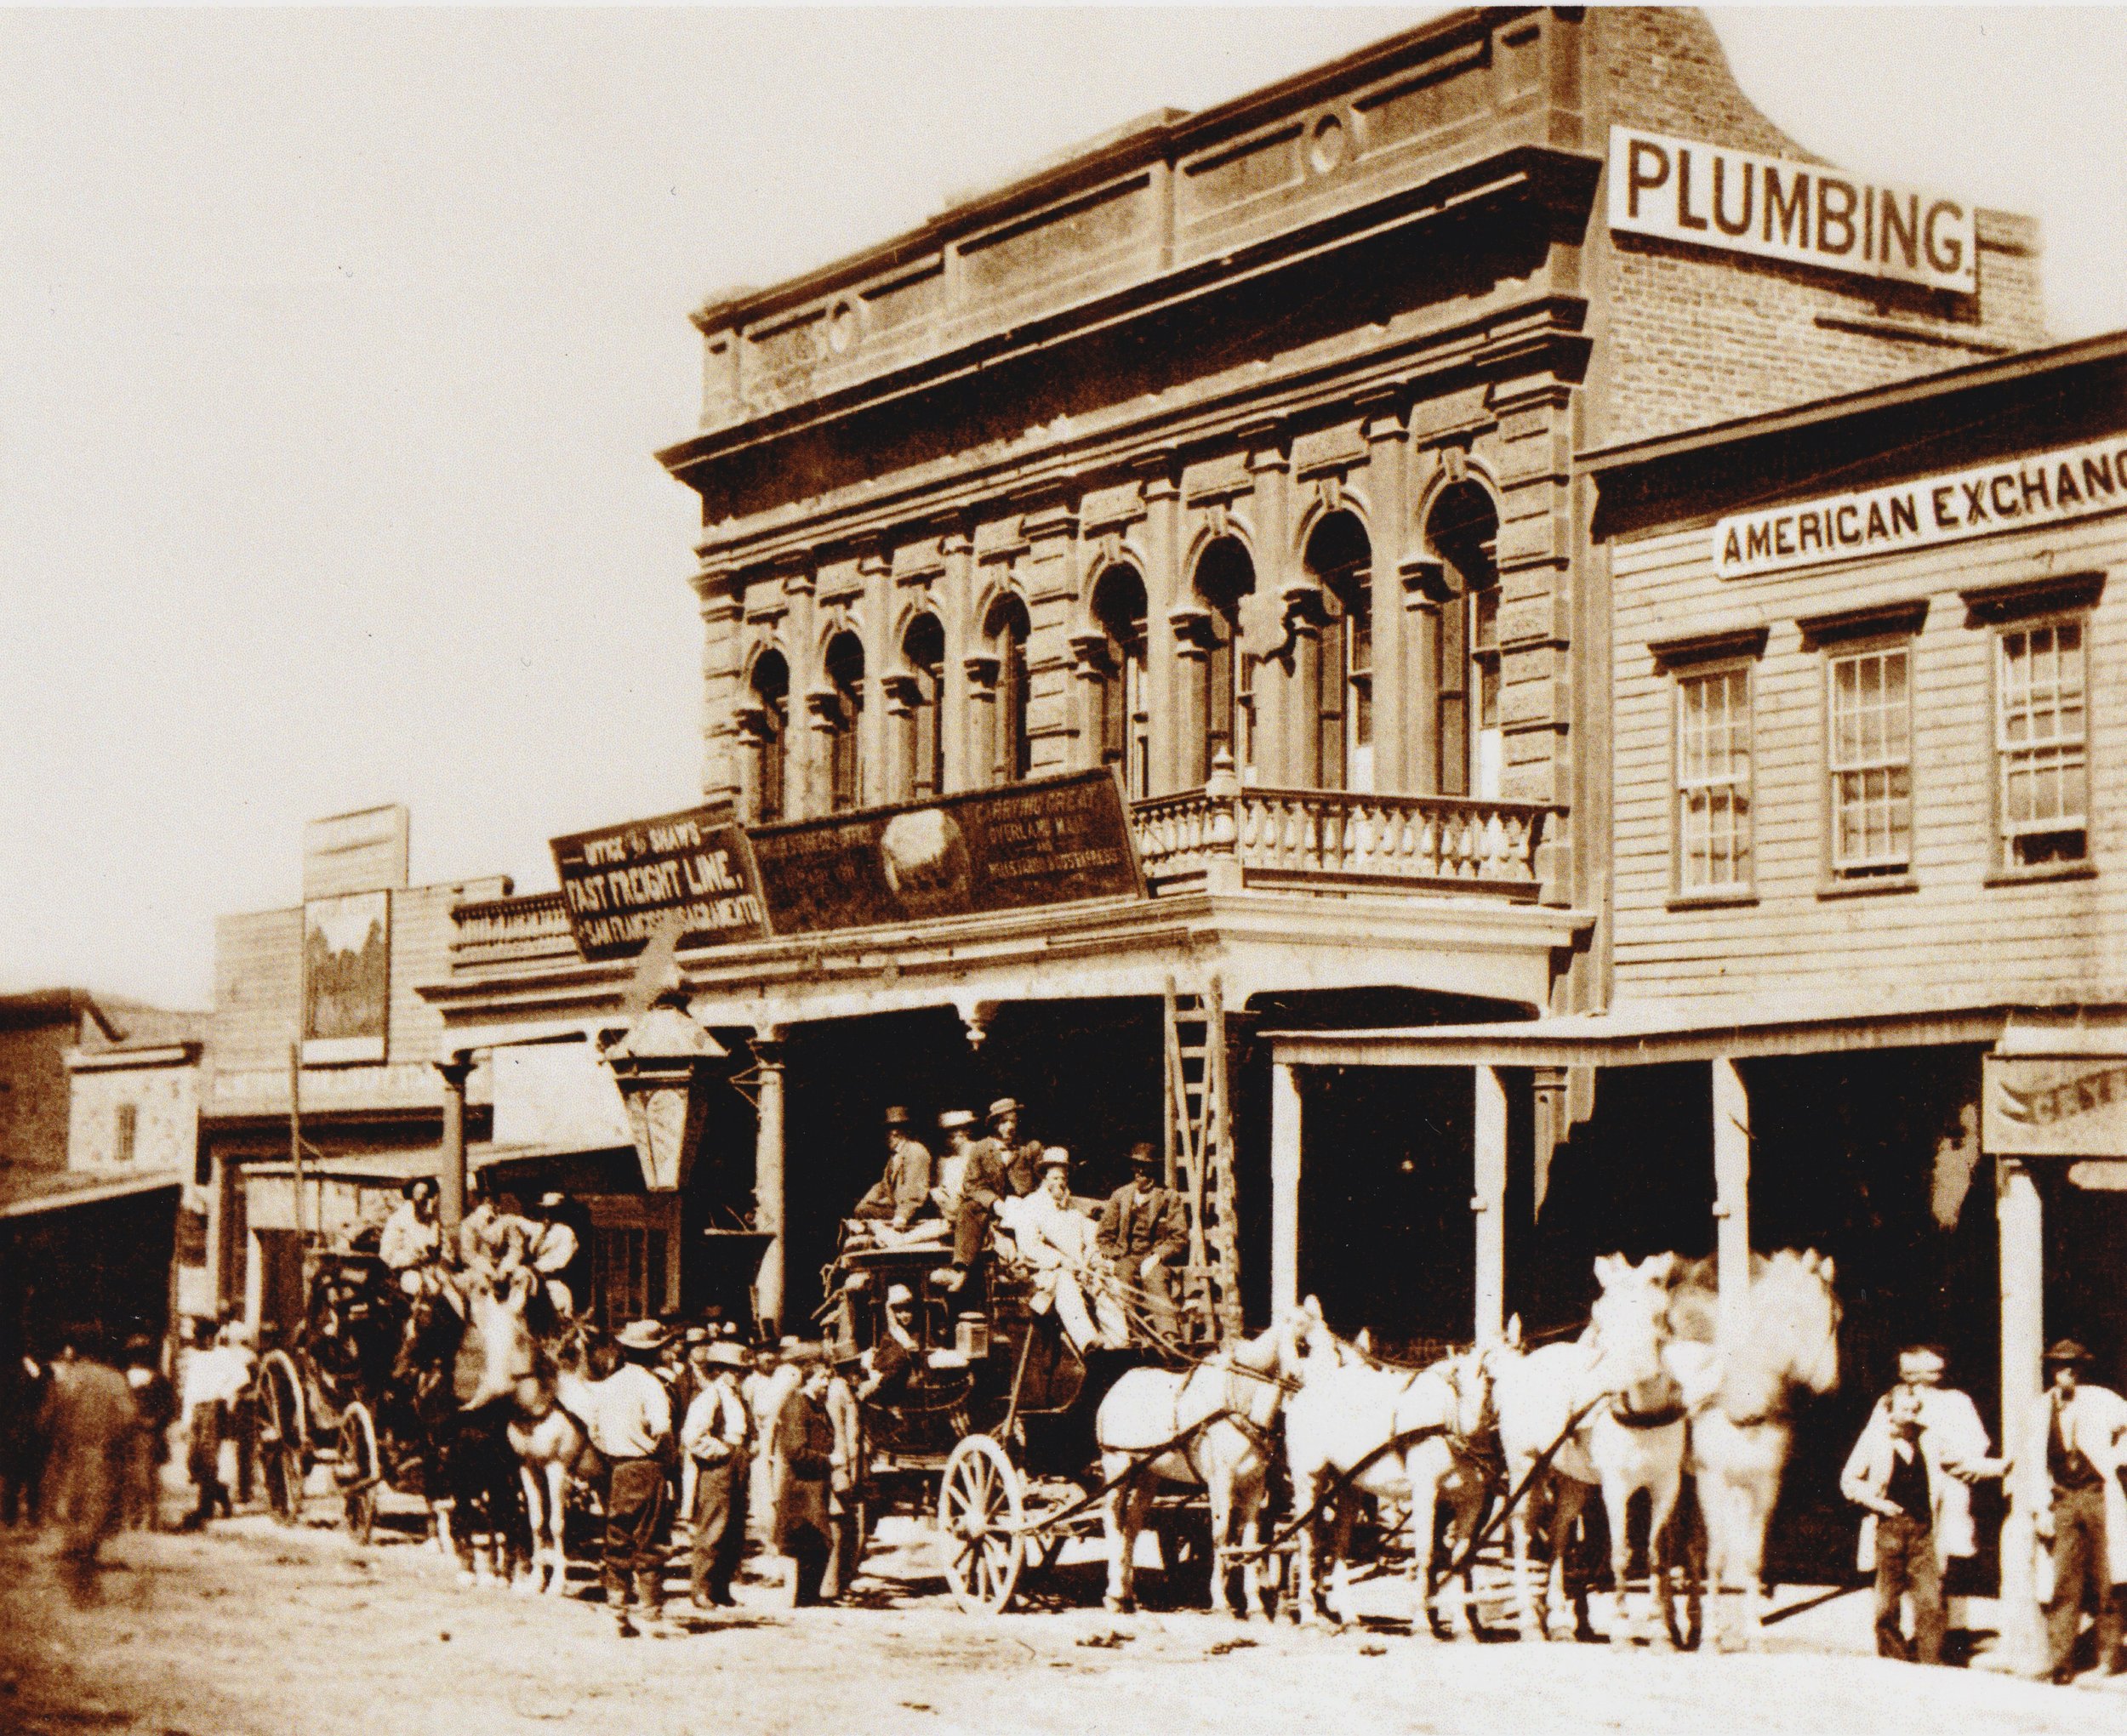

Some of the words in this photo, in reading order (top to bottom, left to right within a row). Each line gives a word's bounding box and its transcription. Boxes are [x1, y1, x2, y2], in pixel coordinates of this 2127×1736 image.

[1722, 492, 1919, 565] AMERICAN
[566, 874, 607, 914] FAST
[607, 860, 681, 908] FREIGHT
